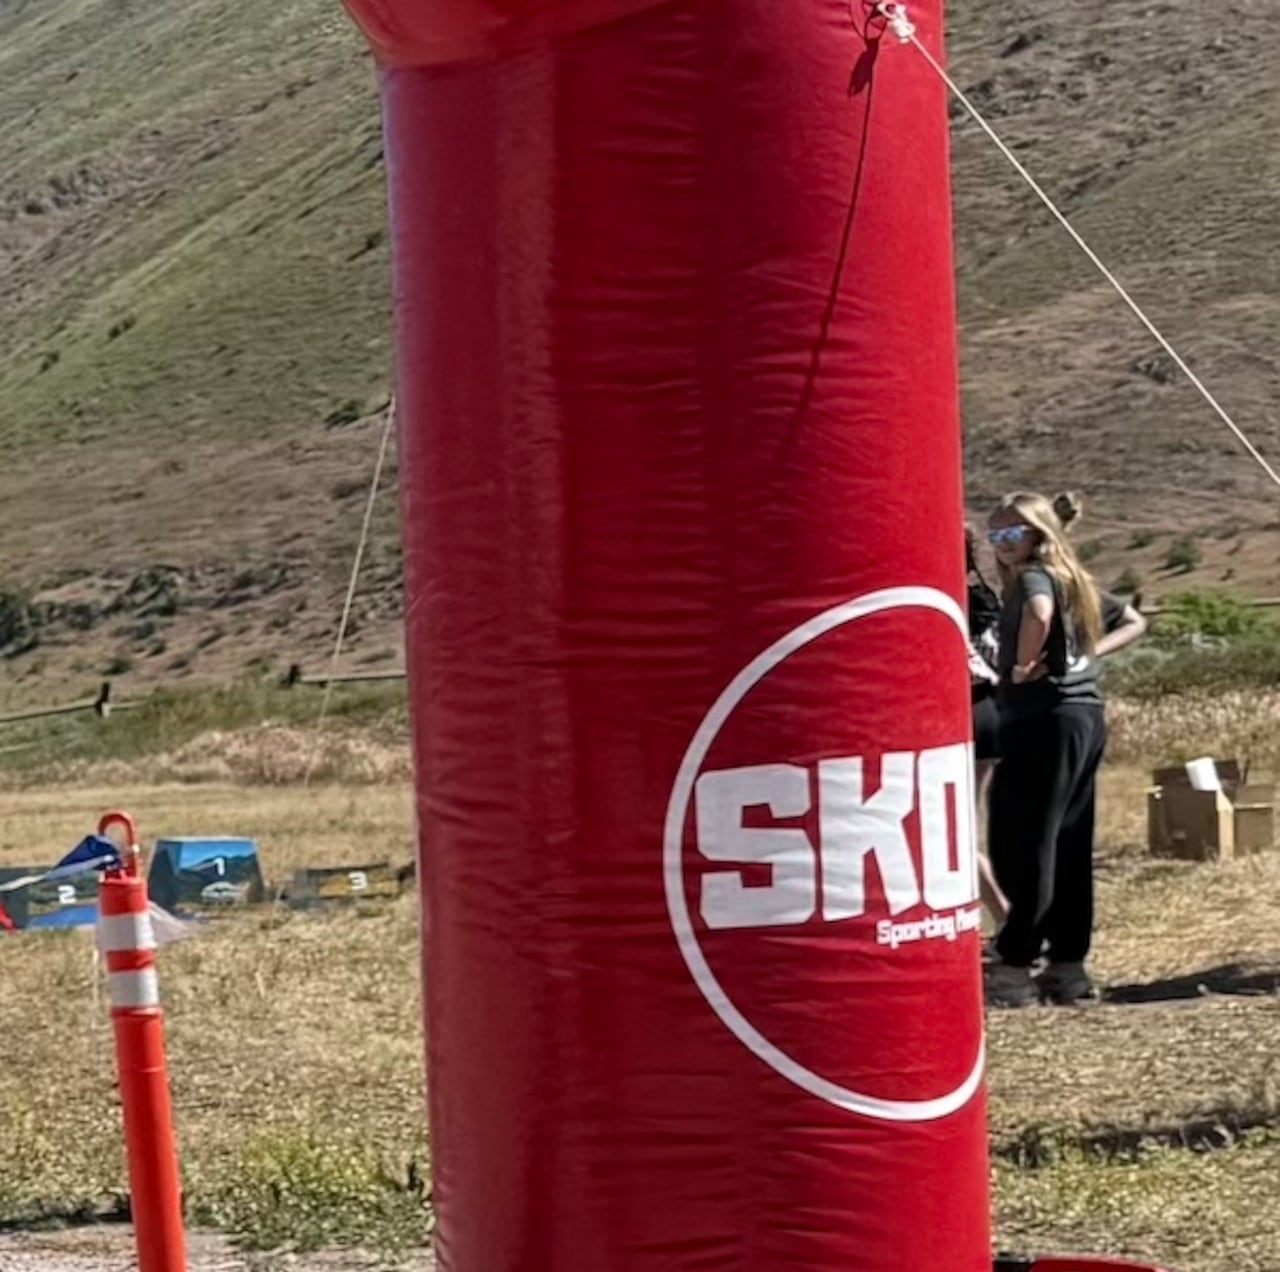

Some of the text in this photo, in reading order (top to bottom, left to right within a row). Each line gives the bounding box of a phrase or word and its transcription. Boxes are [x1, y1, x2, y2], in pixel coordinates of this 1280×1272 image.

[695, 741, 979, 930] SKO
[213, 856, 226, 876] 1
[348, 871, 368, 891] 3
[57, 884, 77, 904] 2
[877, 913, 957, 949] Sporting
